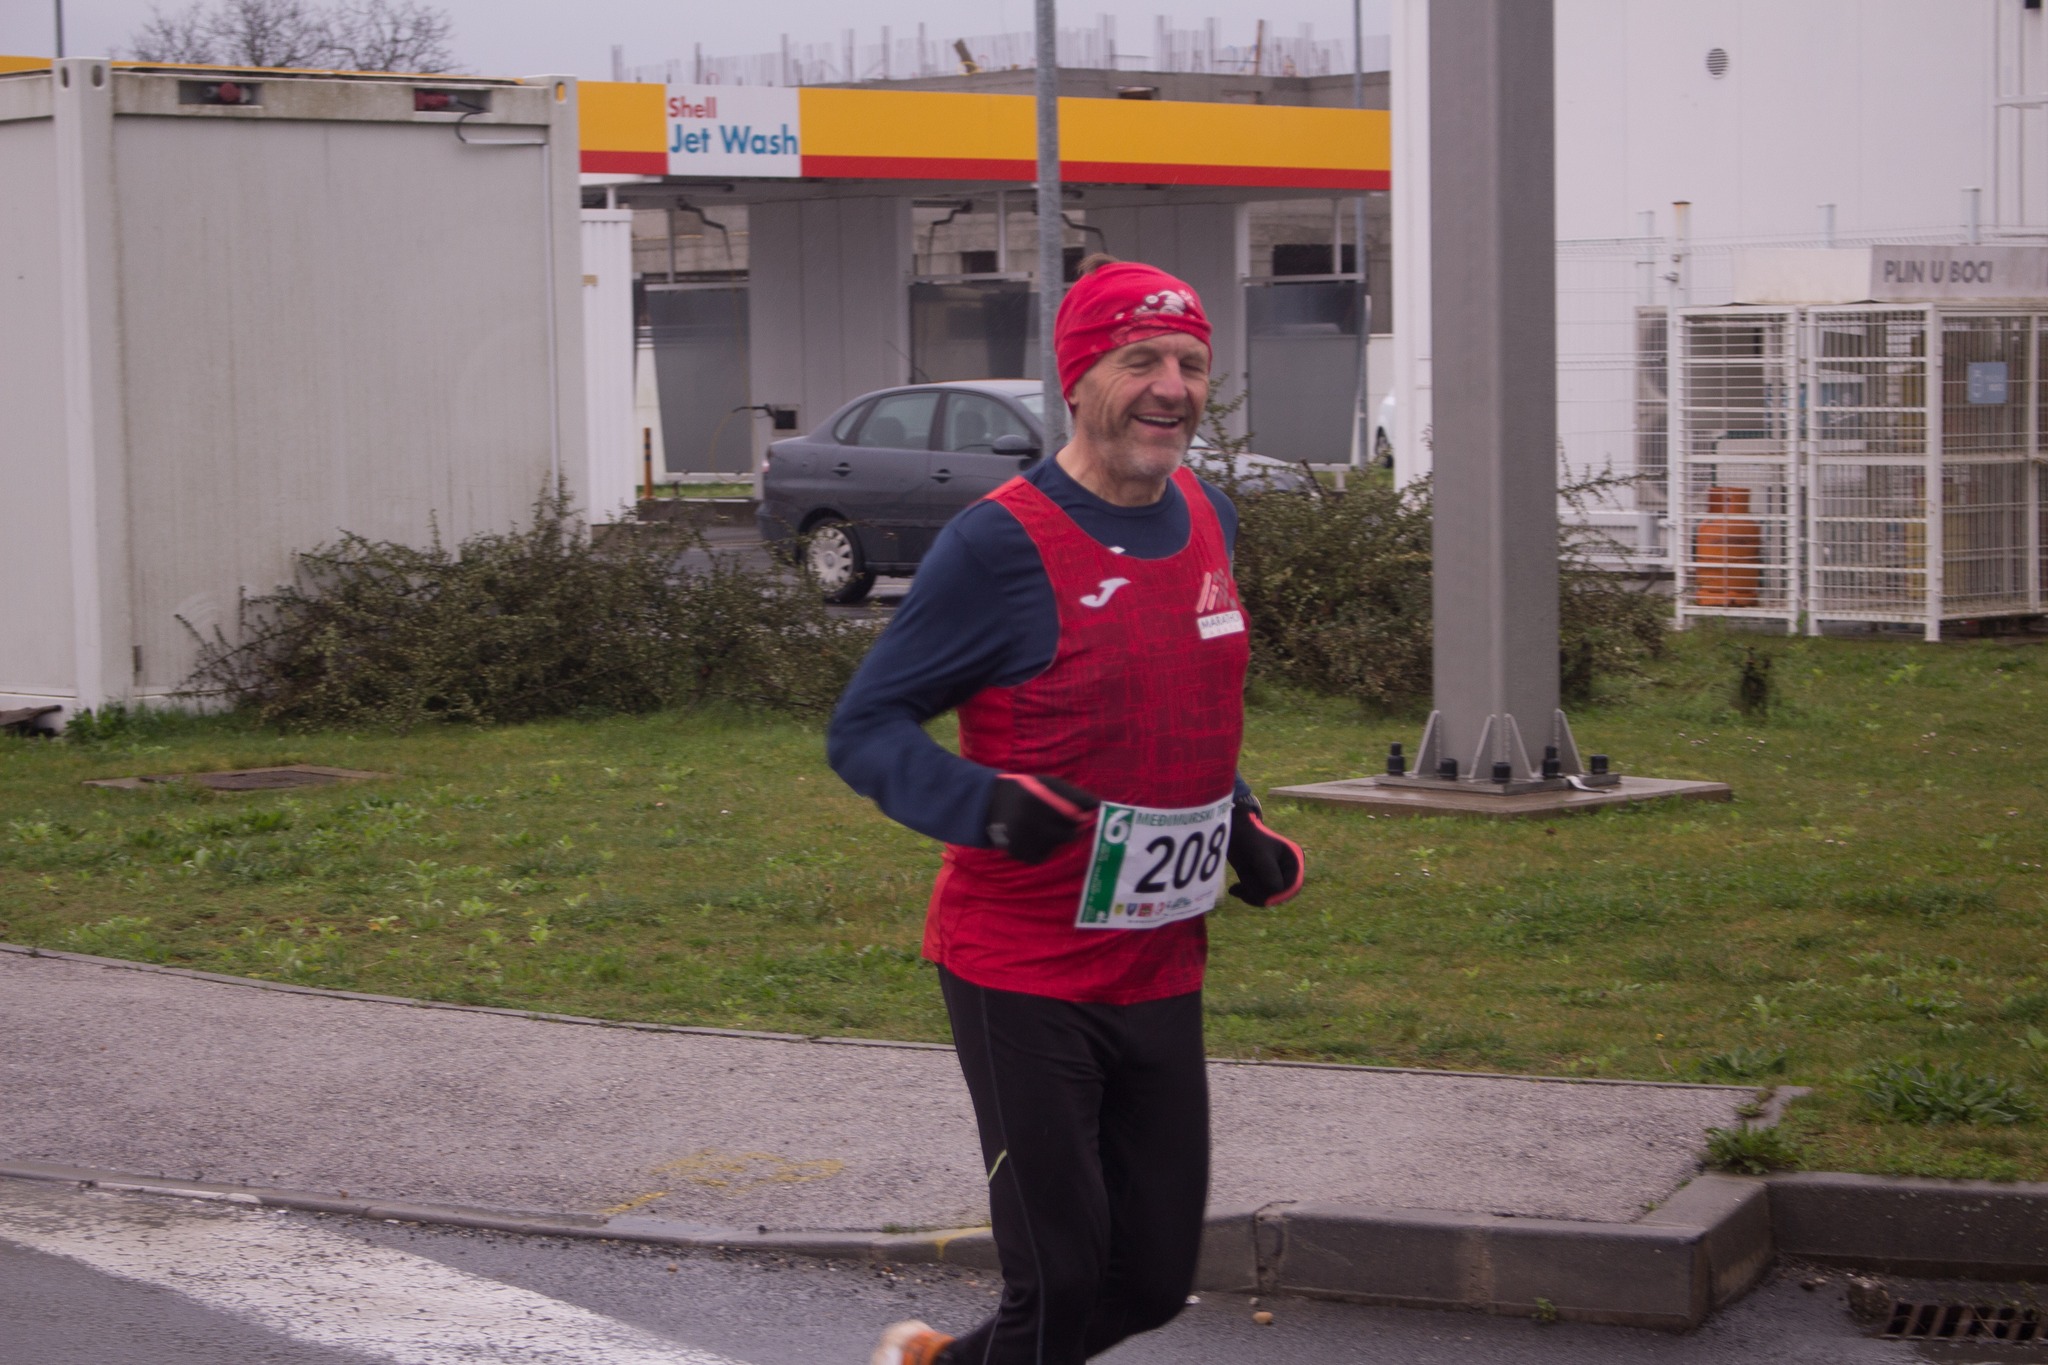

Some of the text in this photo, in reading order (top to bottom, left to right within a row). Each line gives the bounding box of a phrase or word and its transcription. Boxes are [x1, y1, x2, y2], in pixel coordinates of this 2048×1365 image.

[668, 96, 717, 118] Shell
[670, 123, 798, 155] Jet Wash
[1884, 260, 1993, 284] PLIN U BOCI
[1134, 821, 1227, 893] 208
